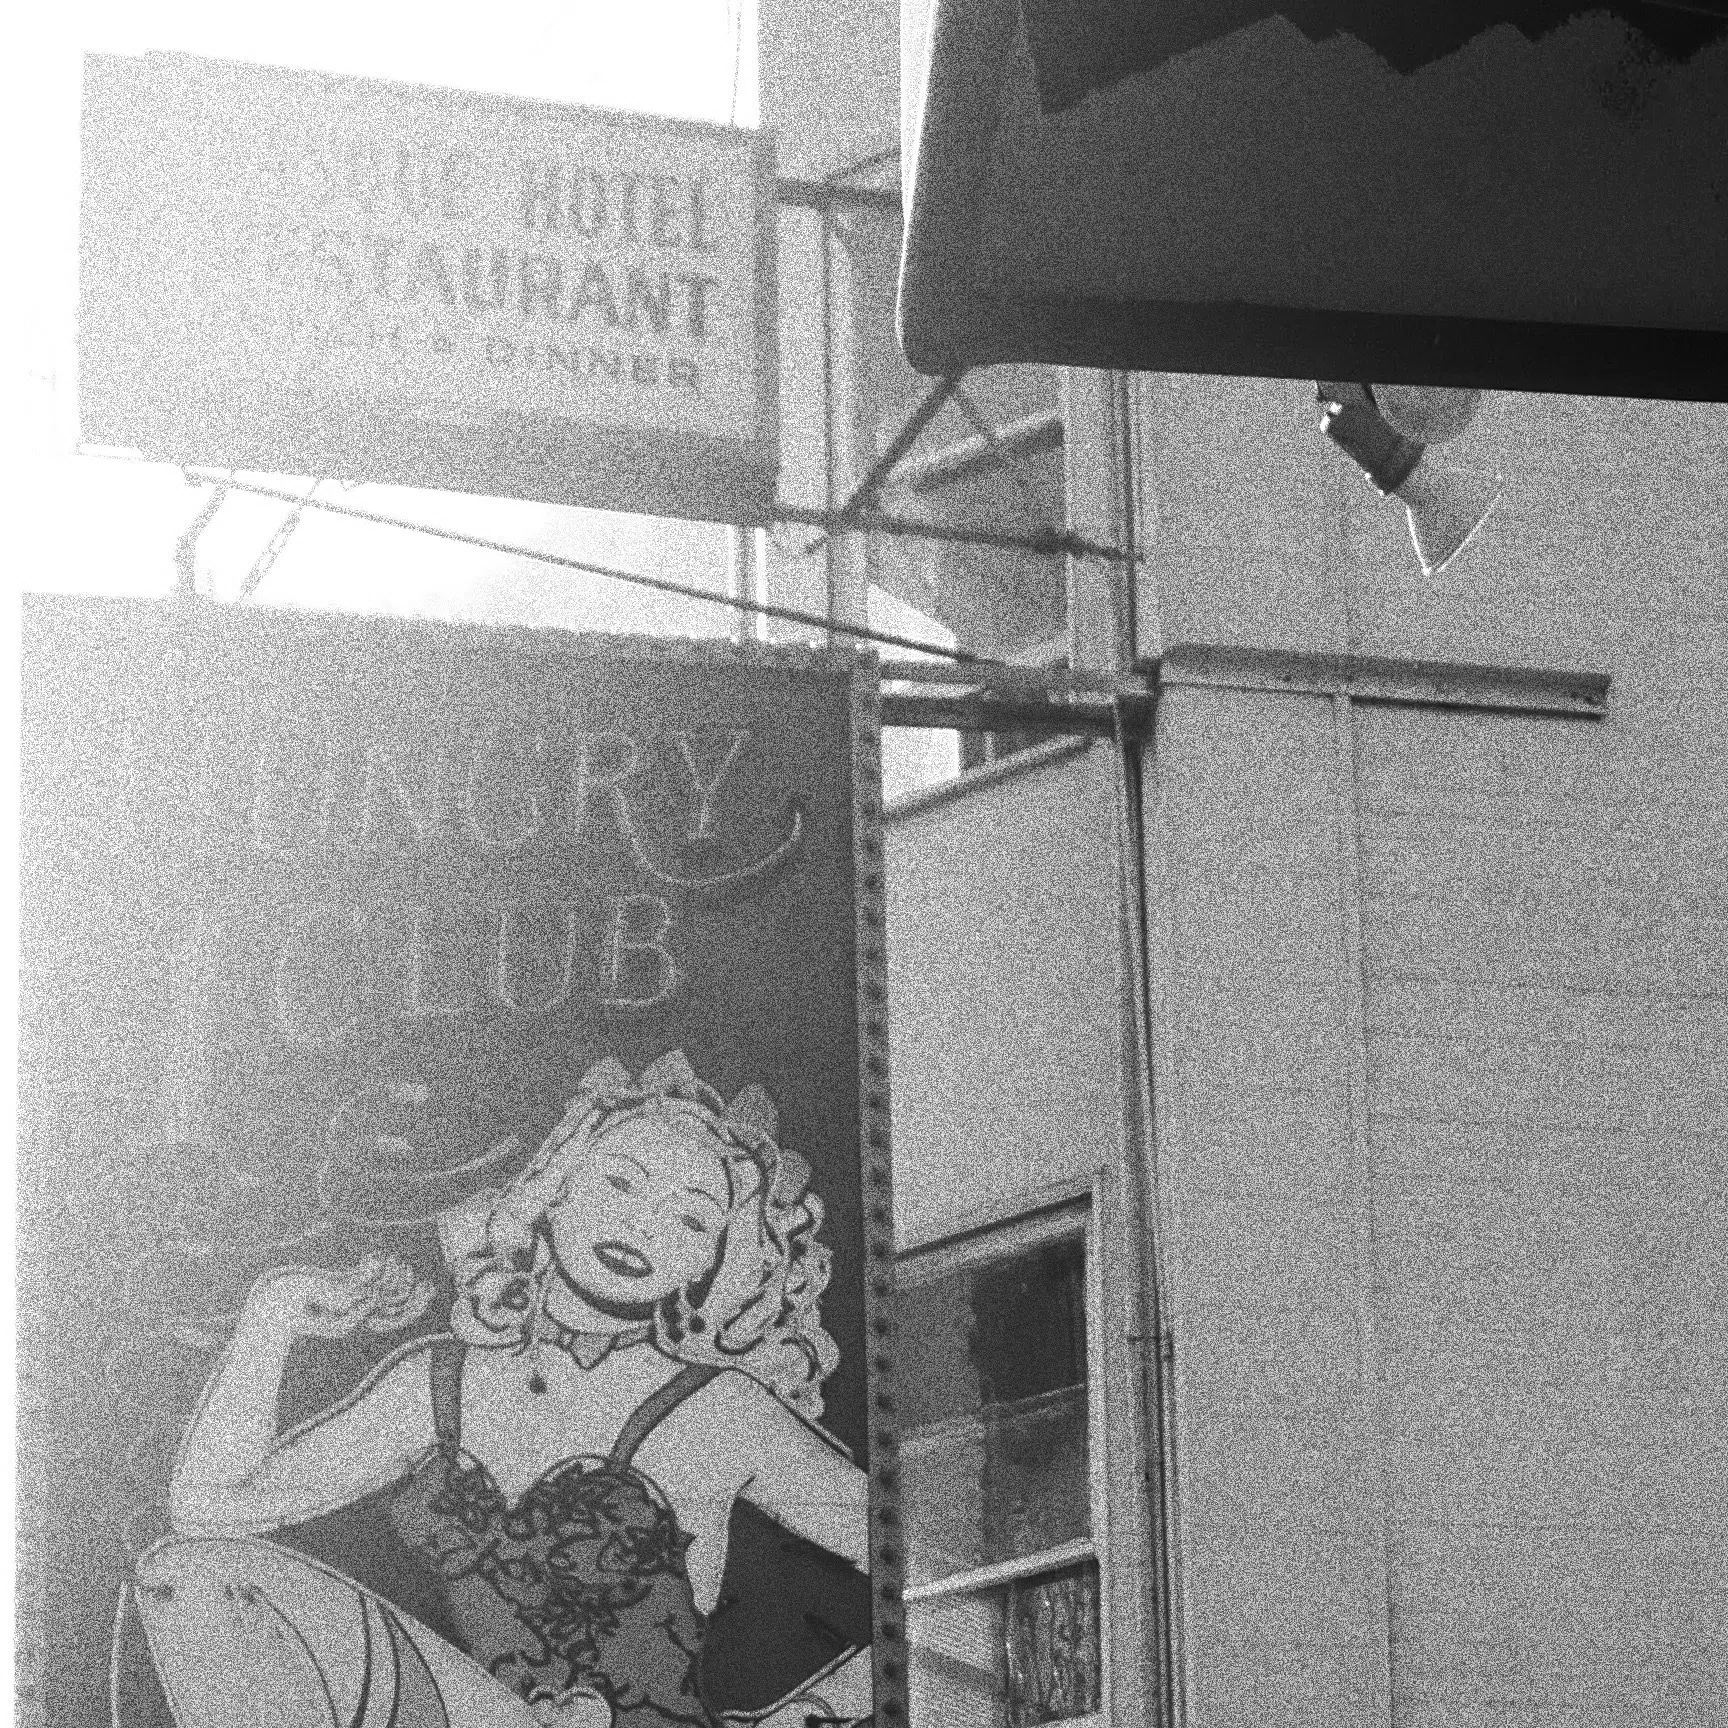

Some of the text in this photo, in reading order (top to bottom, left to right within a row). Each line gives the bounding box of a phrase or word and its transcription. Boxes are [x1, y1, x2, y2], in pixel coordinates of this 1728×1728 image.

[523, 160, 718, 252] HOTEL
[308, 228, 718, 341] STAURANT
[273, 893, 688, 1048] CLUB
